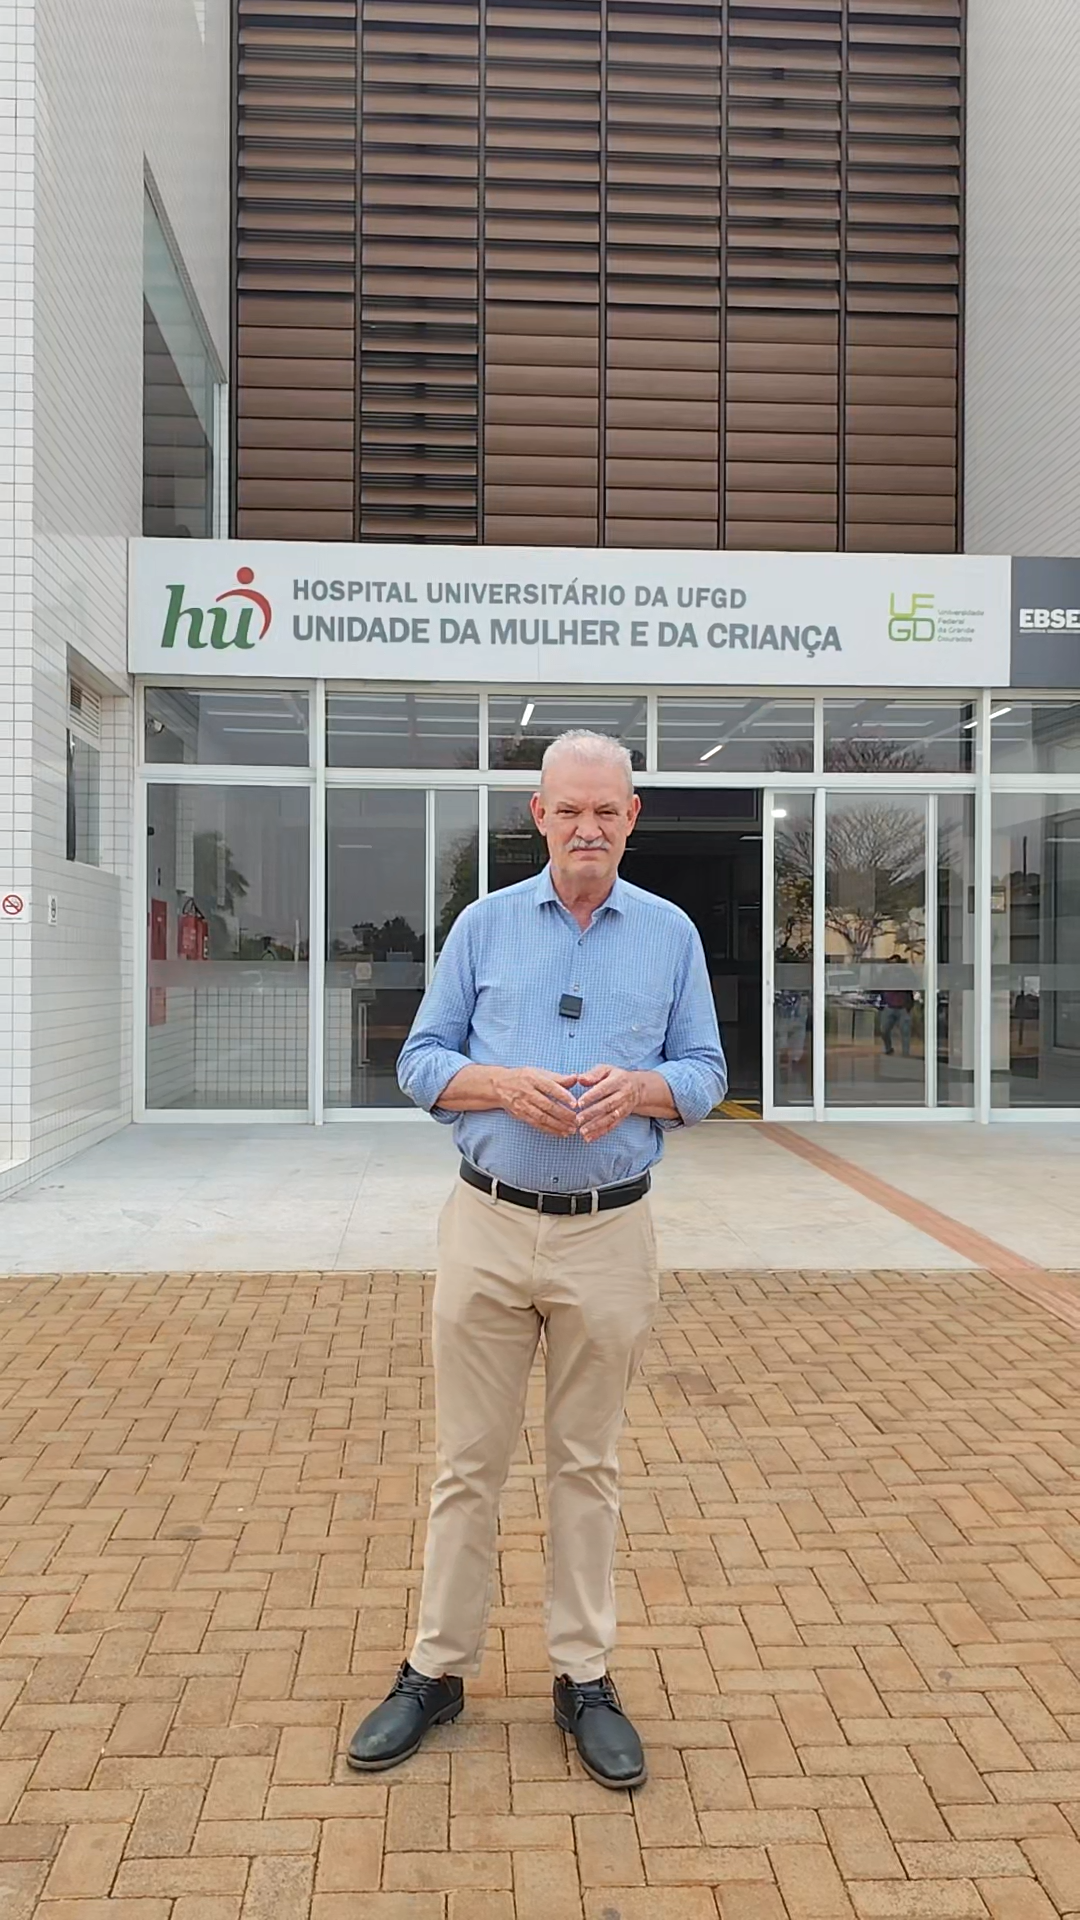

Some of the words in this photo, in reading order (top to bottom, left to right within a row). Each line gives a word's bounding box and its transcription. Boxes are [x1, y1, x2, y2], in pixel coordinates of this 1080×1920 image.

[293, 579, 418, 604] HOSPITAL
[427, 577, 626, 606] UNIVERSITÁRIO
[635, 586, 669, 607] DA
[677, 587, 747, 609] UFGD
[161, 584, 256, 649] hu
[1019, 608, 1080, 628] EBSE
[292, 615, 431, 643] UNIDADE
[439, 619, 482, 644] DA
[490, 619, 621, 646] MULHER
[630, 621, 649, 646] E
[658, 622, 699, 648] DA
[707, 623, 843, 659] CRIANÇA
